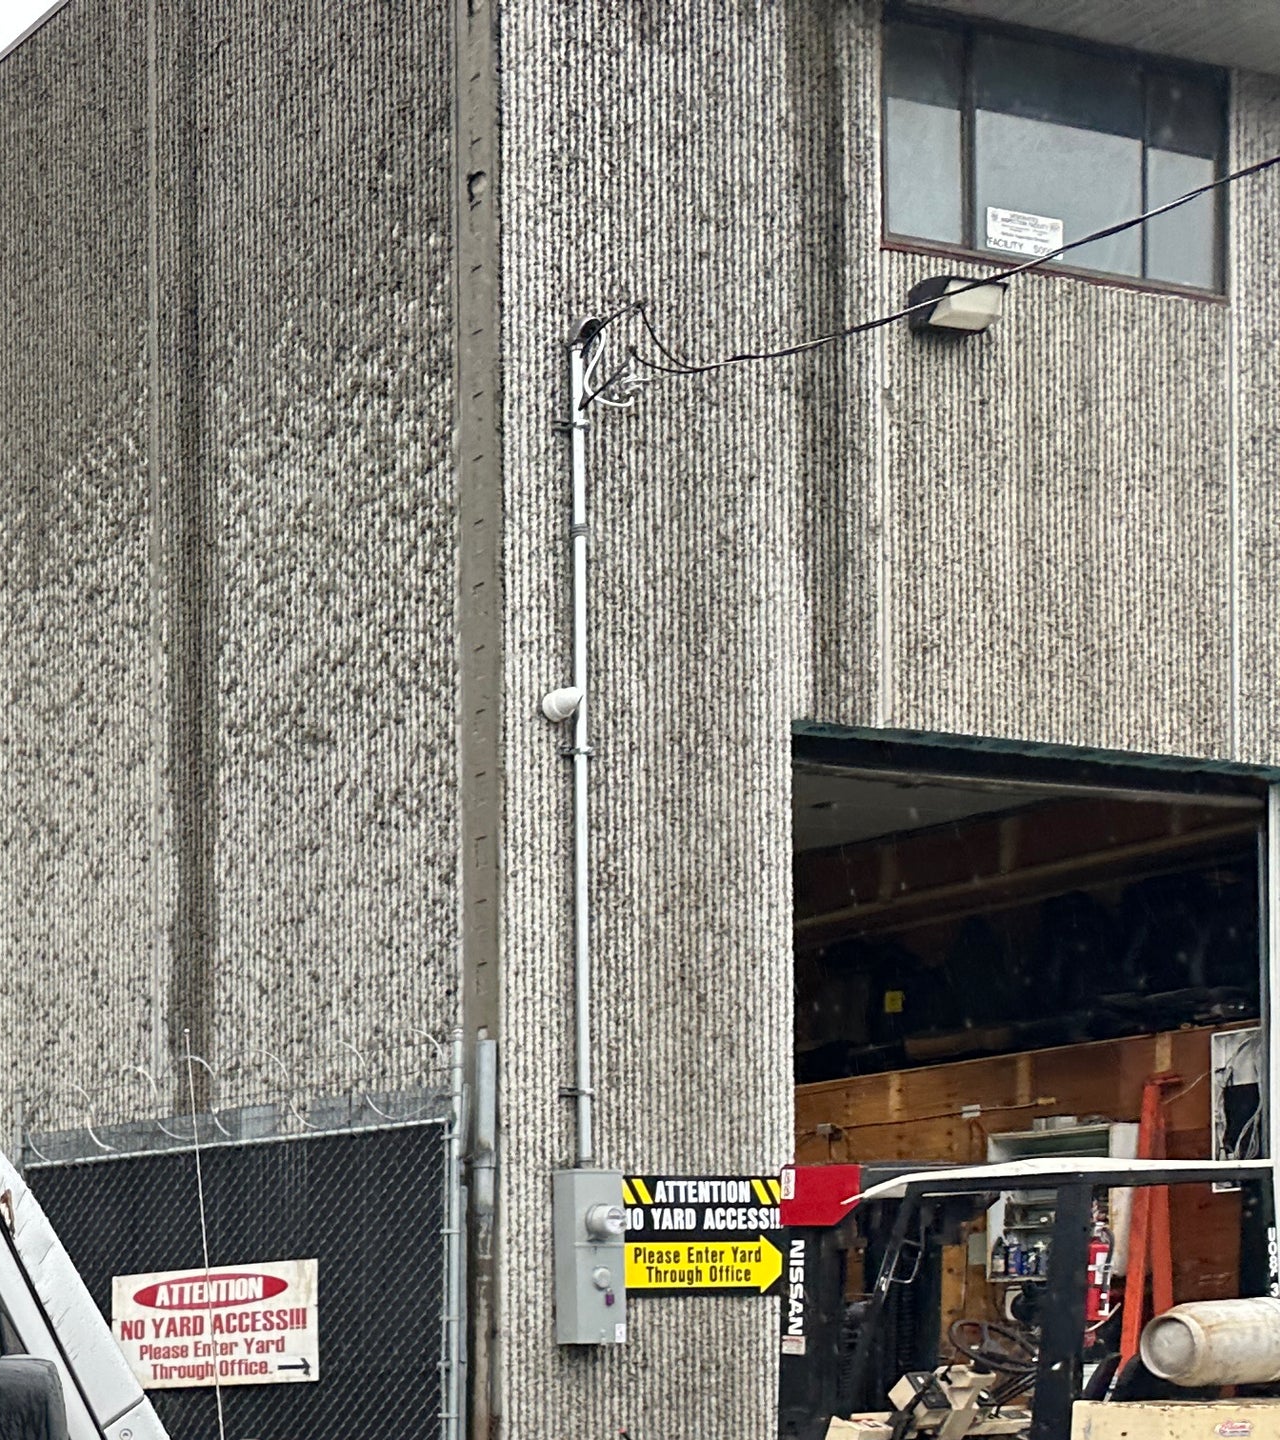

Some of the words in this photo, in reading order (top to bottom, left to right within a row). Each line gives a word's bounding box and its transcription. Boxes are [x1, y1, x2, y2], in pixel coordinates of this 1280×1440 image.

[654, 1180, 751, 1204] ATTENTION
[650, 1207, 697, 1230] YARD
[633, 1246, 681, 1264] Please
[687, 1246, 725, 1263] Enter
[731, 1246, 762, 1263] Yard
[646, 1265, 703, 1285] Through
[709, 1265, 751, 1282] Office
[154, 1276, 264, 1307] ATTENTION
[787, 1239, 805, 1336] NISSAN
[120, 1319, 145, 1341] NO
[152, 1315, 205, 1339] YARD
[213, 1308, 307, 1335] ACCESS!!!
[139, 1344, 189, 1361] Please
[194, 1340, 239, 1357] Enter
[244, 1336, 285, 1354] Yard
[151, 1360, 215, 1381] Through
